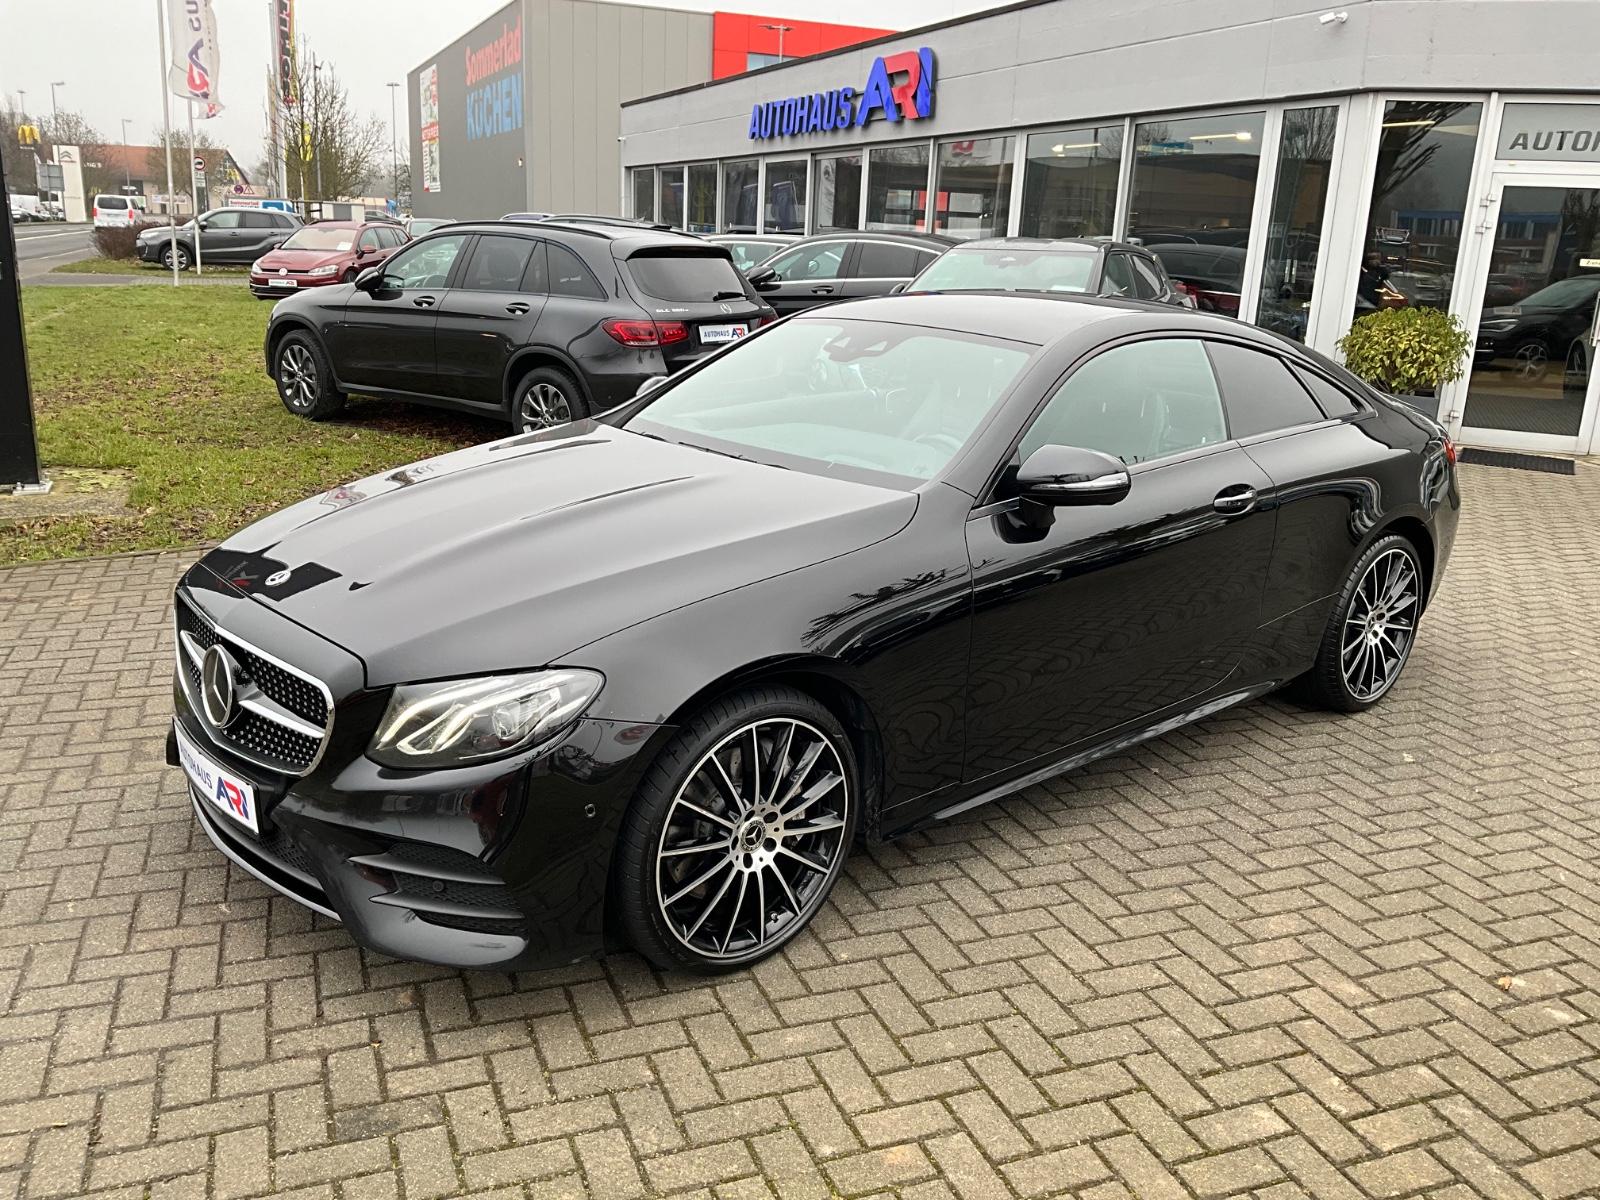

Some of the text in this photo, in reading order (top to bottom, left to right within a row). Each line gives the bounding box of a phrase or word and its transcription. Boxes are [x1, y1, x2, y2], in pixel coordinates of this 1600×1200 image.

[465, 15, 522, 87] Sommerlad
[465, 72, 523, 142] KÜCHEN
[748, 47, 935, 139] AUTOHAUS ARI
[216, 776, 250, 820] ARI
